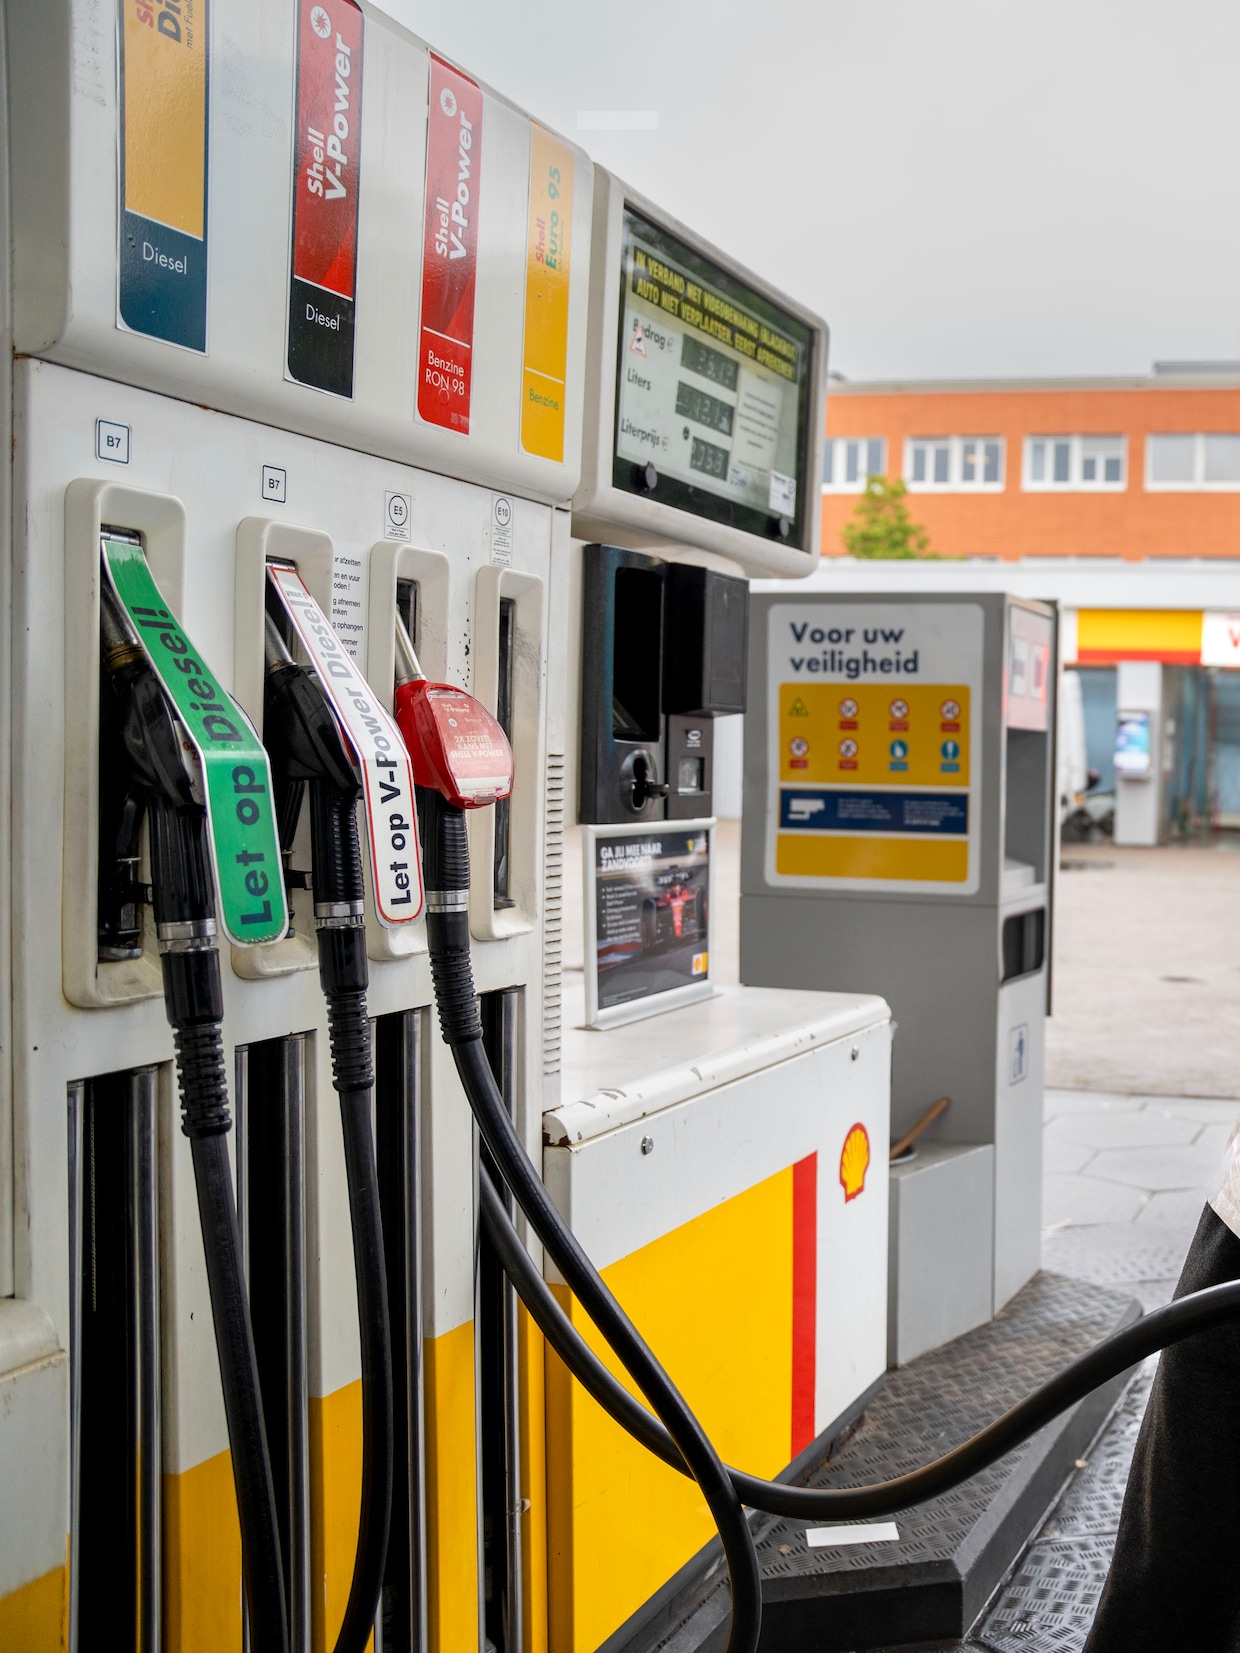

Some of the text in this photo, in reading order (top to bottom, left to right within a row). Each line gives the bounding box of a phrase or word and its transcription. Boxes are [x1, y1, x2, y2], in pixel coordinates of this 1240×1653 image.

[325, 31, 351, 200] V-Power
[306, 127, 325, 197] Shell
[450, 111, 473, 260] V-Power
[435, 197, 449, 257] Shell
[545, 166, 561, 270] Euro 95
[535, 217, 546, 263] Shell
[143, 242, 187, 275] Diesel
[647, 257, 685, 295] VERBAND
[306, 303, 340, 331] Diesel
[636, 277, 660, 305] AUTO
[661, 291, 680, 316] NIET
[734, 332, 757, 358] EERST
[428, 350, 465, 377] Benzine
[627, 367, 652, 391] Liters
[425, 368, 465, 396] RON 98
[529, 388, 559, 410] Benzine
[106, 435, 121, 449] B7
[621, 418, 660, 449] Literprijs
[268, 478, 280, 490] B7
[393, 505, 403, 516] E5
[497, 507, 509, 517] E10
[337, 621, 363, 631] ophangen
[789, 621, 905, 645] Voor uw
[130, 605, 244, 742] Diesel!
[789, 649, 920, 680] veiligheid
[345, 686, 402, 804] V-Power
[450, 749, 504, 759] SHELL V-POWER
[457, 742, 493, 751] KANS MET
[231, 765, 266, 826] op
[389, 813, 410, 851] op
[600, 846, 614, 860] GA
[625, 844, 641, 858] MEE
[641, 842, 663, 857] NAAR
[235, 850, 273, 925] Let
[390, 861, 412, 905] Let
